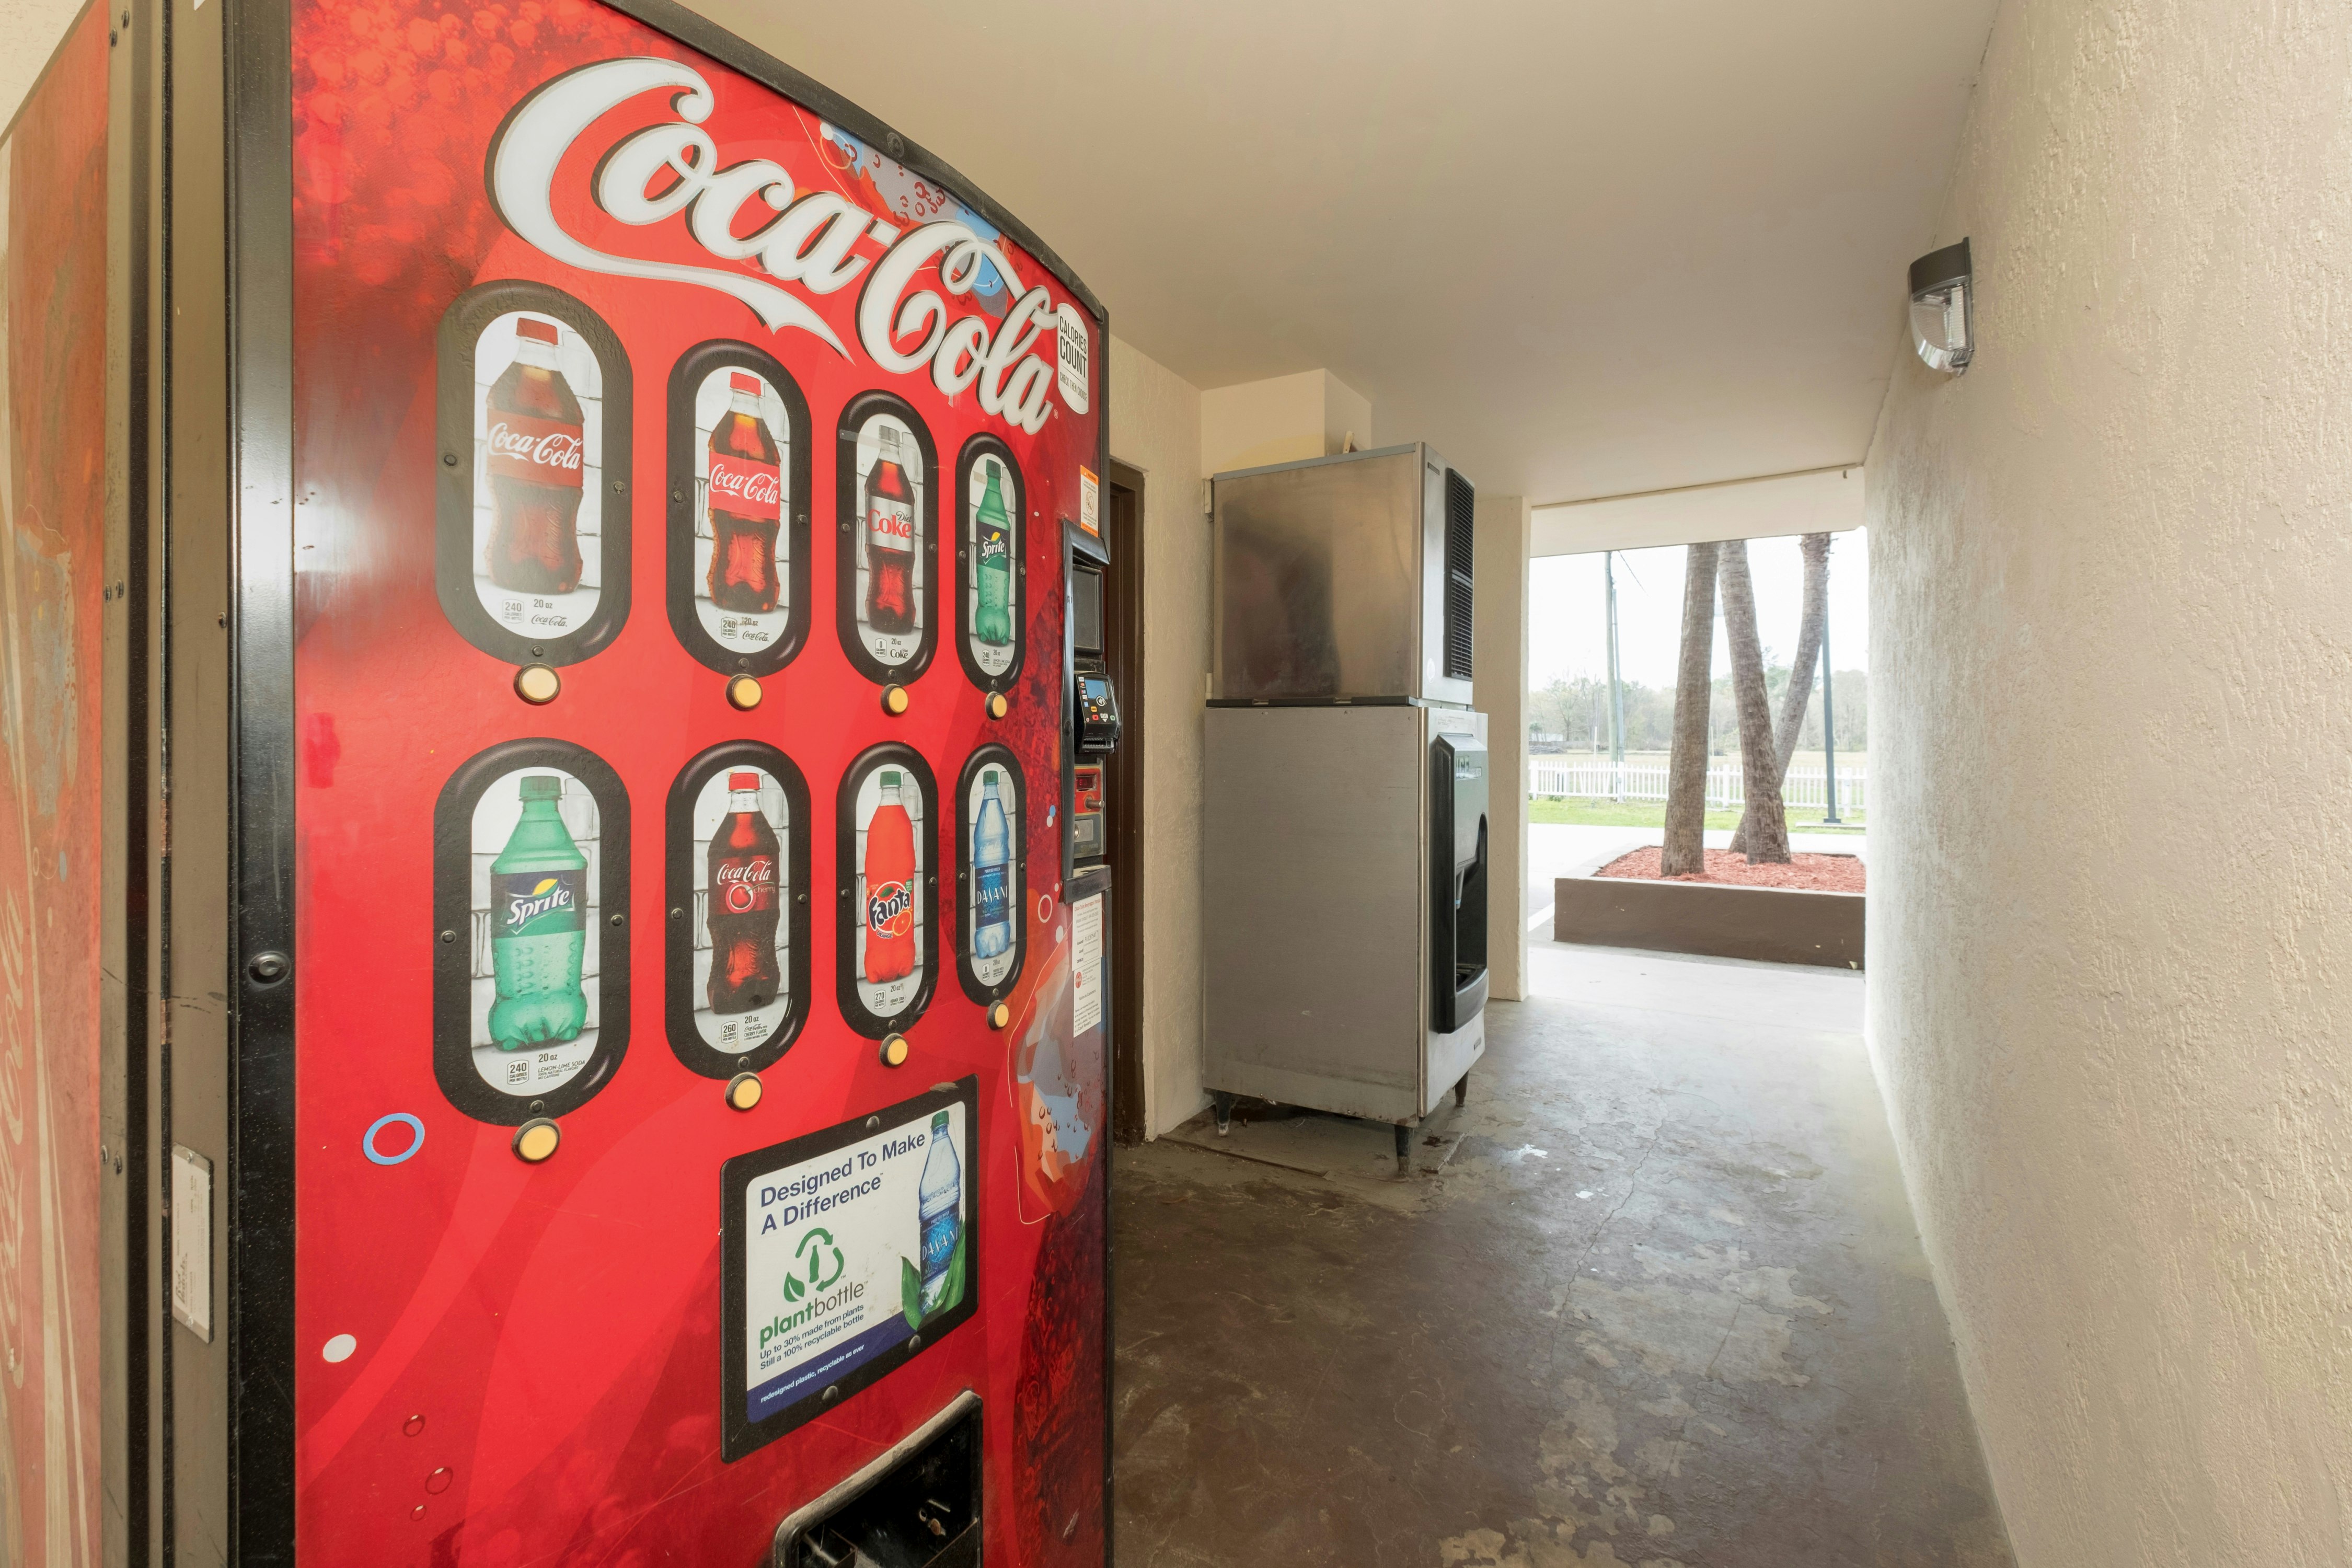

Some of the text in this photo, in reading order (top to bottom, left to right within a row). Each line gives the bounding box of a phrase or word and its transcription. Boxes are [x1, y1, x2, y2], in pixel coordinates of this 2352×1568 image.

[489, 57, 1057, 435] Coca-Cola
[1060, 315, 1087, 355] CALORIES
[1060, 336, 1087, 378] COUNT
[1060, 372, 1069, 389] CHECK
[1077, 386, 1087, 402] CHOOSE
[488, 422, 583, 469] Coca-Cola
[710, 463, 779, 504] Coca-Cola
[867, 509, 912, 538] Coke
[896, 511, 912, 523] Diet
[982, 540, 1005, 559] Sprite
[505, 602, 522, 612] 240
[534, 598, 544, 608] 20
[531, 614, 568, 627] Coca-Cola
[723, 620, 736, 629] 240
[742, 630, 769, 642] Coca-Cola
[890, 649, 909, 659] Coke
[717, 860, 773, 885] Coca-Cola
[753, 885, 776, 894] cherry
[977, 885, 1007, 904] DASANI
[506, 886, 570, 925] Sprite
[869, 888, 910, 931] Fanta
[877, 930, 893, 939] ORANGE
[875, 992, 884, 1000] 270
[723, 1024, 736, 1033] 260
[745, 1016, 752, 1024] 20
[510, 1063, 527, 1074] 240
[538, 1053, 548, 1063] 20
[538, 1062, 571, 1073] LEMON-LIME
[0, 883, 24, 1389] CocaCola
[760, 1133, 925, 1207] Designed To Make
[761, 1175, 882, 1235] A Difference
[922, 1226, 958, 1261] DASANI
[760, 1282, 864, 1350] plantbottle
[760, 1350, 772, 1359] Up
[784, 1334, 800, 1347] 30%
[802, 1323, 823, 1339] made
[824, 1315, 841, 1328] from
[843, 1304, 864, 1320] plants
[760, 1356, 775, 1370] Still
[784, 1344, 803, 1358] 100%
[804, 1324, 841, 1348] recyclable
[843, 1313, 864, 1329] bottle
[760, 1381, 794, 1403] redesigned
[795, 1370, 816, 1387] plastic,
[817, 1355, 845, 1374] recyclable
[853, 1344, 865, 1355] ever
